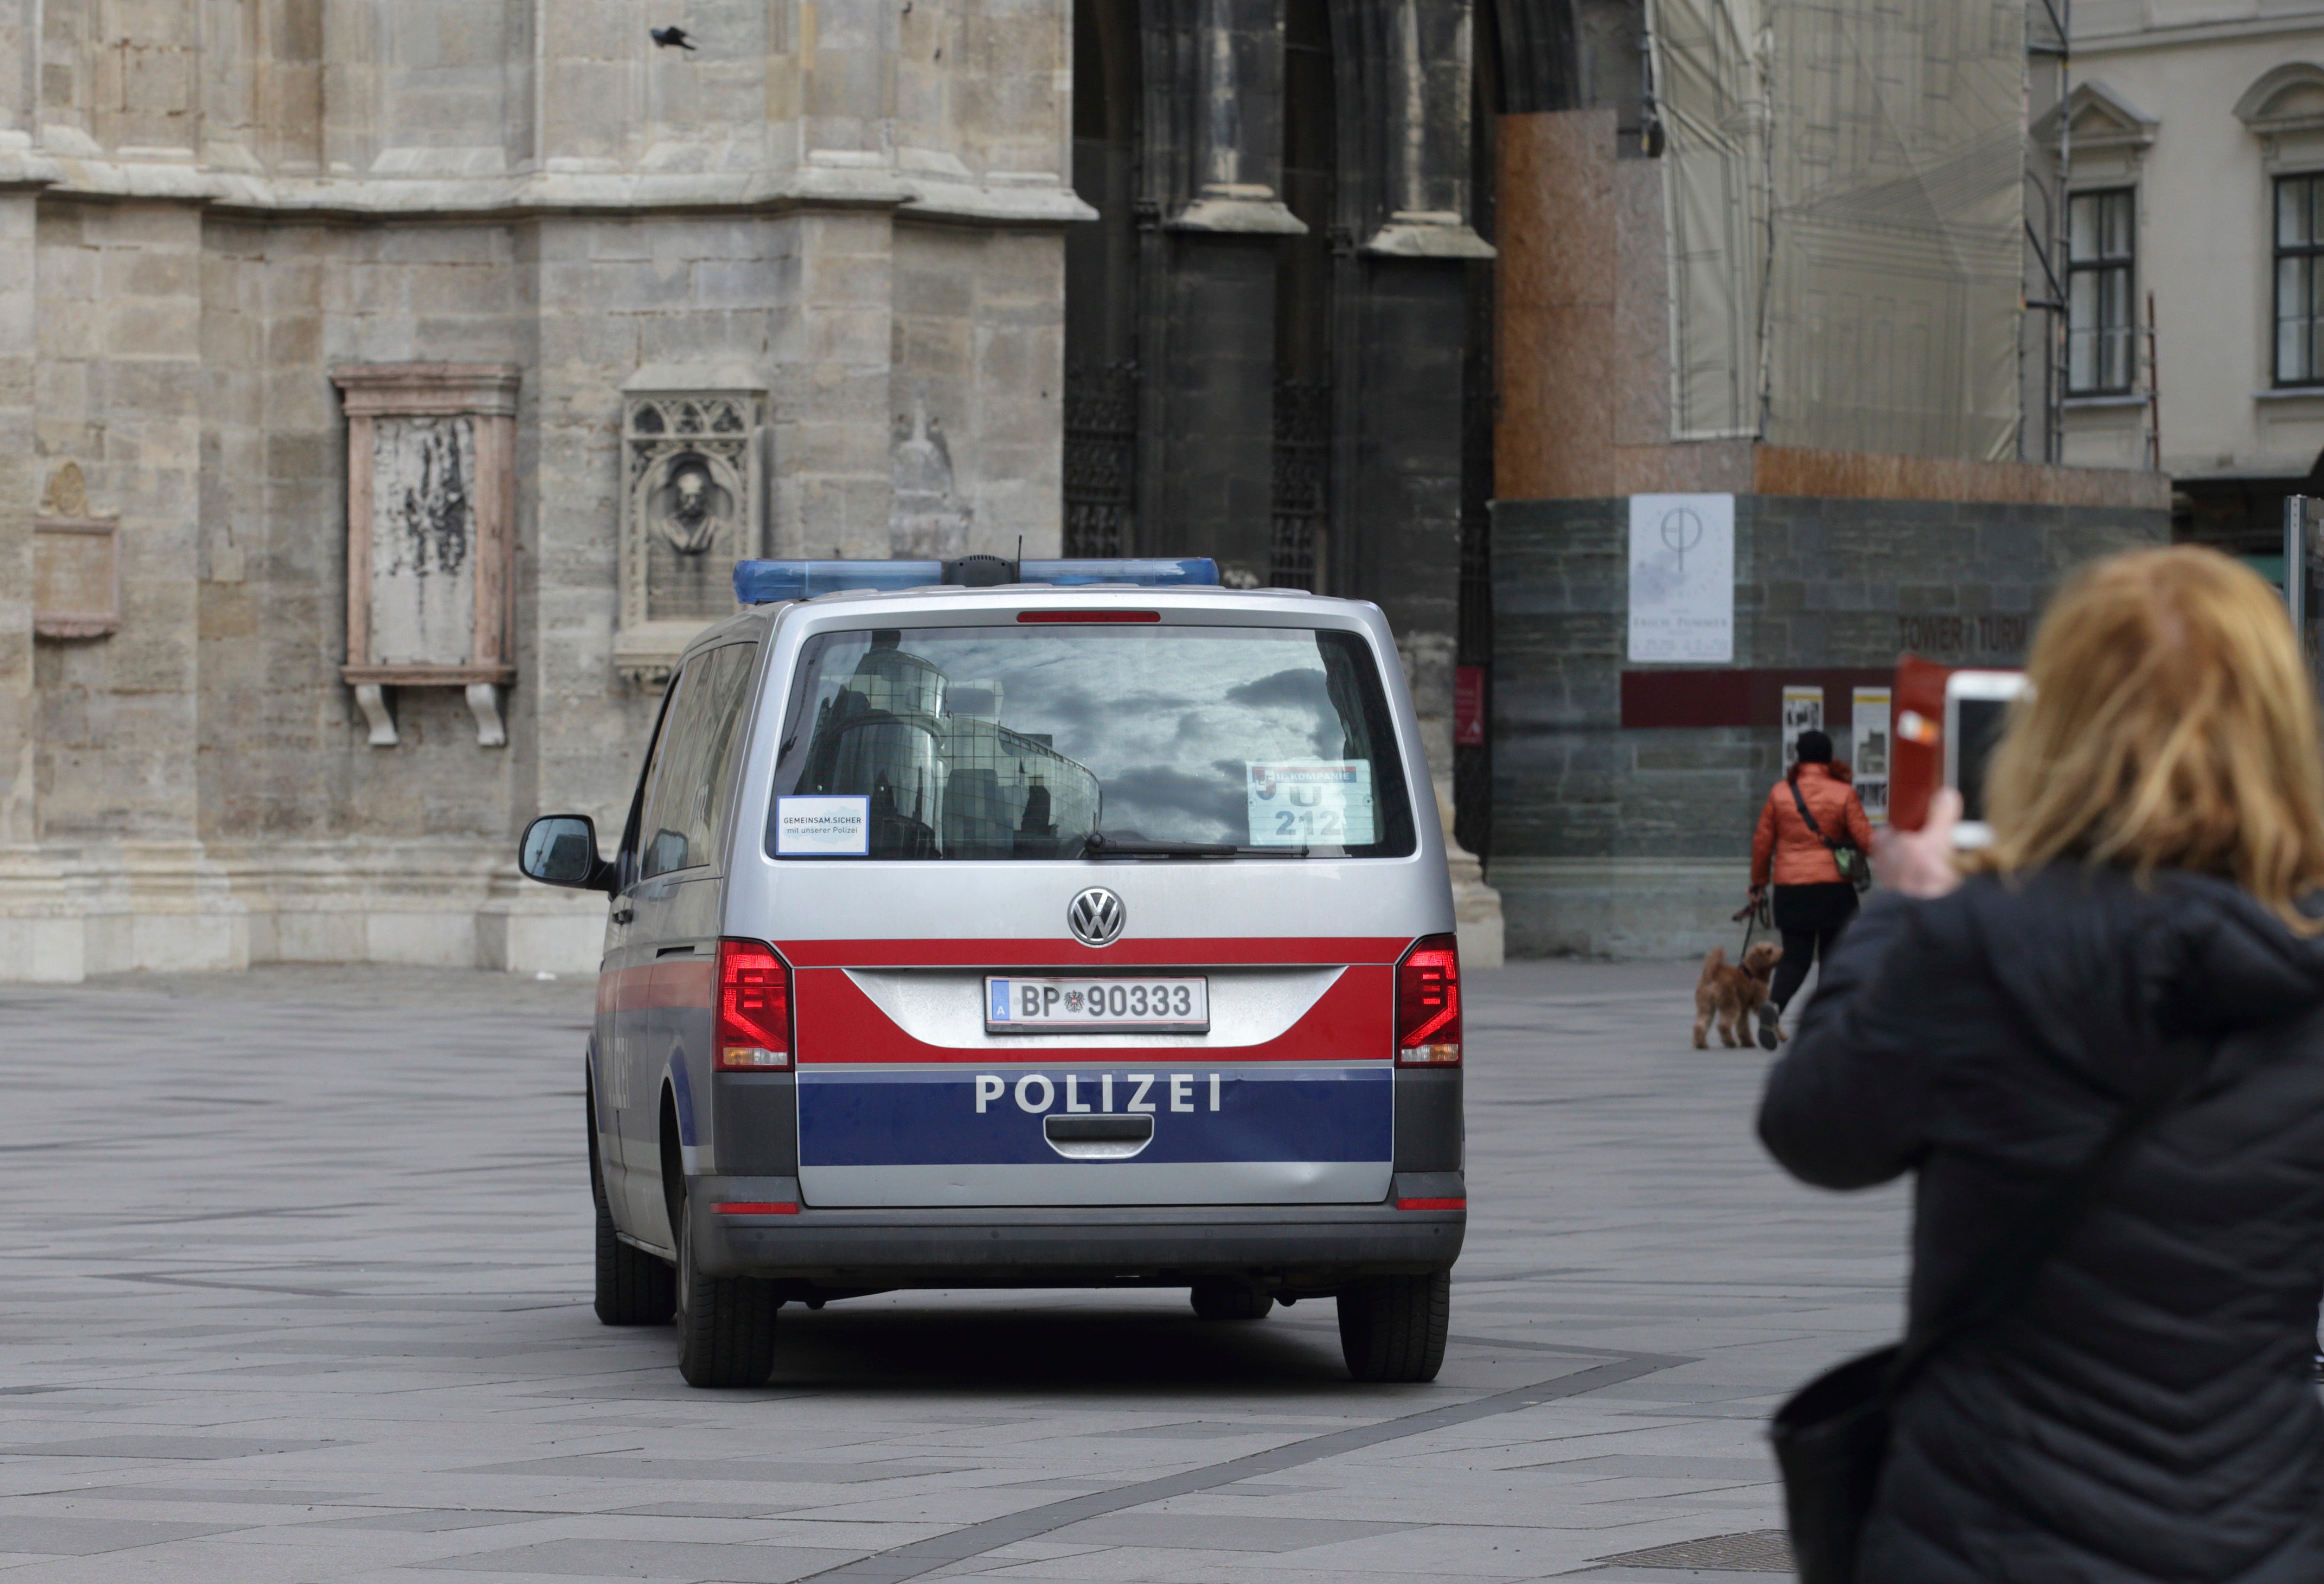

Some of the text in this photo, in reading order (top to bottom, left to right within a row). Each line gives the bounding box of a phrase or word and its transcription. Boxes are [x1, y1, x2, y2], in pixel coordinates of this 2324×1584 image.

[1897, 615, 1963, 651] TOWER
[1979, 615, 2027, 651] TURM
[1290, 772, 1350, 780] KOMPANIE
[1289, 786, 1322, 807] U
[1275, 810, 1341, 836] 212
[1071, 889, 1123, 942] VW
[997, 1006, 1005, 1015] A
[1022, 985, 1192, 1017] BP 90333
[975, 1073, 1220, 1113] POLIZEI
